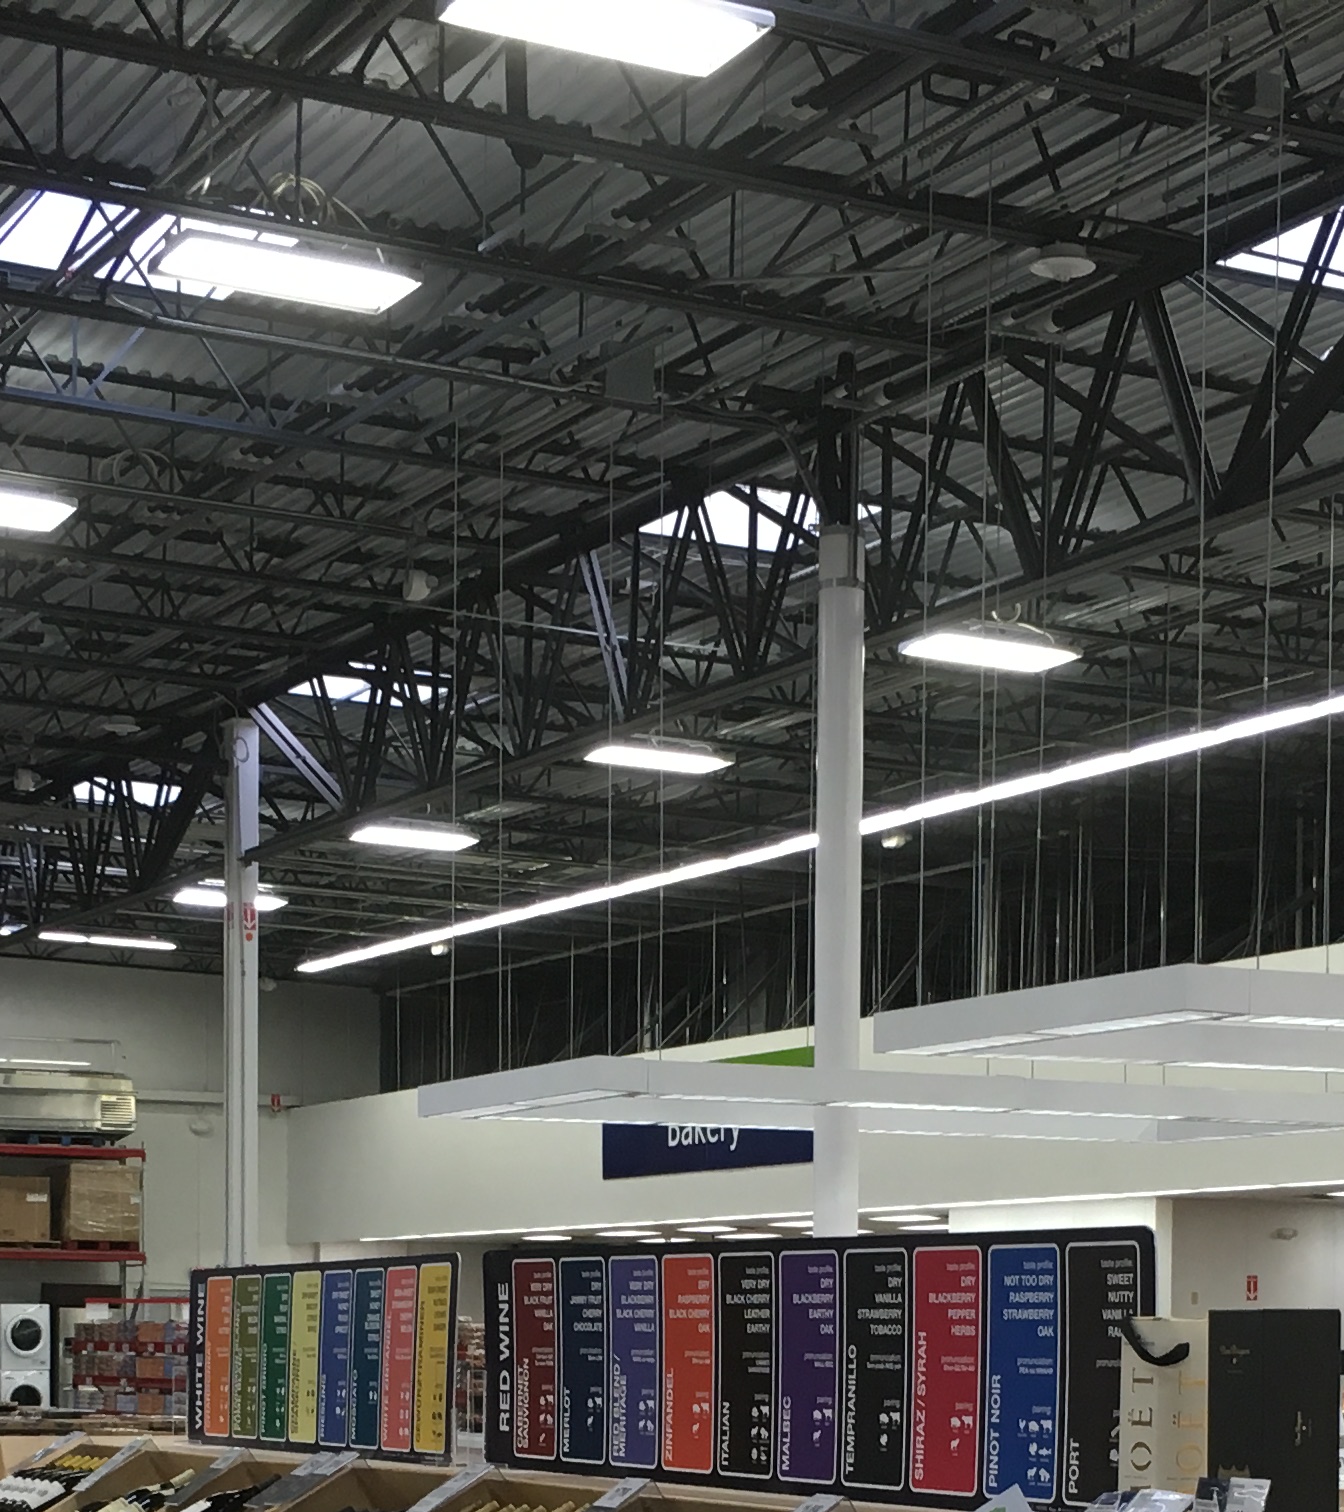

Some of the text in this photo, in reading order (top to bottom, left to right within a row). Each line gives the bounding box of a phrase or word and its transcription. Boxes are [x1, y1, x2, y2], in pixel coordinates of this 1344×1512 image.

[820, 1278, 834, 1288] DRY
[888, 1277, 902, 1288] DRY
[960, 1276, 976, 1287] DRY
[1004, 1275, 1054, 1286] NOT TOO DRY
[1107, 1273, 1133, 1285] SWEET
[874, 1293, 902, 1303] VANILLA
[928, 1292, 976, 1303] BLACKBERRY
[1009, 1292, 1054, 1303] RASPBERRY
[1108, 1291, 1134, 1302] NUTTY
[948, 1308, 976, 1319] PEPPER
[1002, 1308, 1054, 1320] STRAWBERRY
[820, 1324, 834, 1334] OAK
[870, 1324, 902, 1335] TOBACCO
[951, 1325, 976, 1336] HERBS
[1037, 1326, 1054, 1337] OAK
[195, 1283, 205, 1430] WHITE WINE
[497, 1283, 510, 1432] RED WINE
[916, 1331, 927, 1396] SYRAH
[665, 1367, 673, 1461] ZINFANDEL
[845, 1344, 857, 1475] TEMPRANILLO
[563, 1387, 571, 1452] MERLOT
[721, 1401, 730, 1466] ITALIAN
[781, 1396, 791, 1471] MALBEC
[989, 1374, 1001, 1488] PINOT NOIR
[1128, 1367, 1154, 1493] OËT
[612, 1421, 620, 1457] RED
[914, 1410, 926, 1481] SHIRAZ
[1068, 1438, 1080, 1494] PORT
